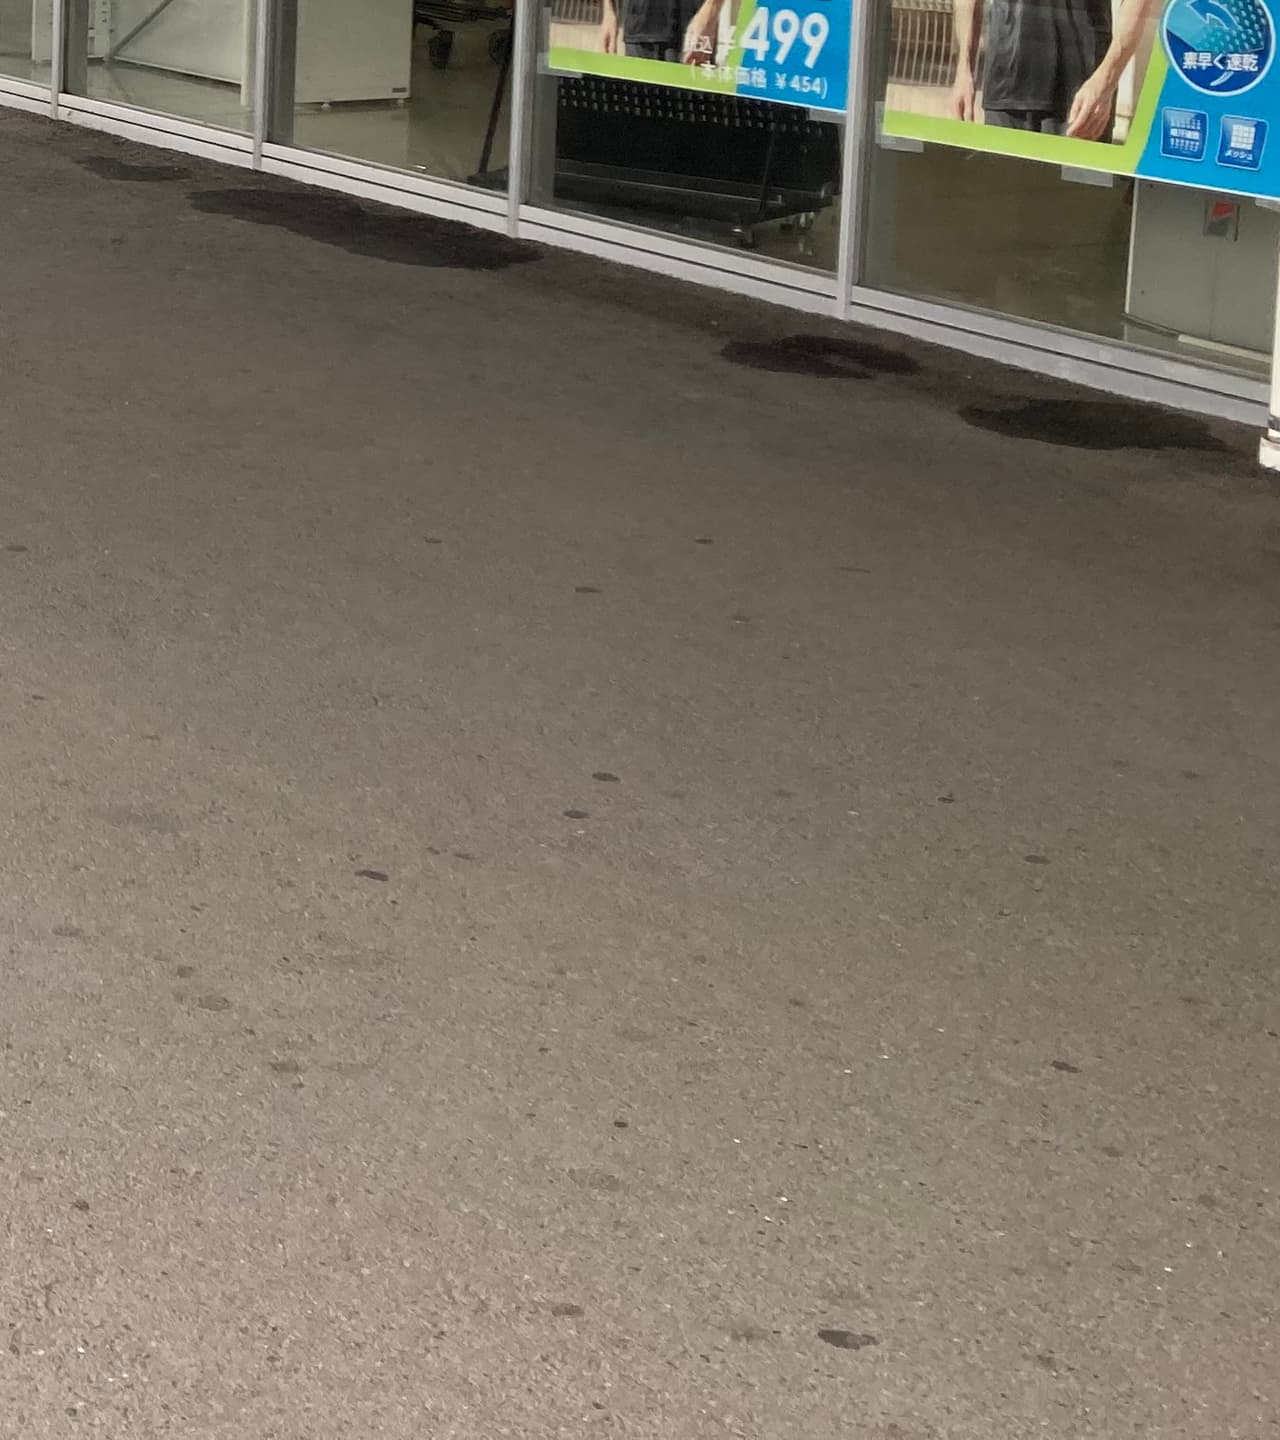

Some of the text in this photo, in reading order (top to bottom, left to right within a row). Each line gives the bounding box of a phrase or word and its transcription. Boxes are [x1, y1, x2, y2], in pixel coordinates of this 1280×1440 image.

[1183, 51, 1259, 72] 素早く速乾
